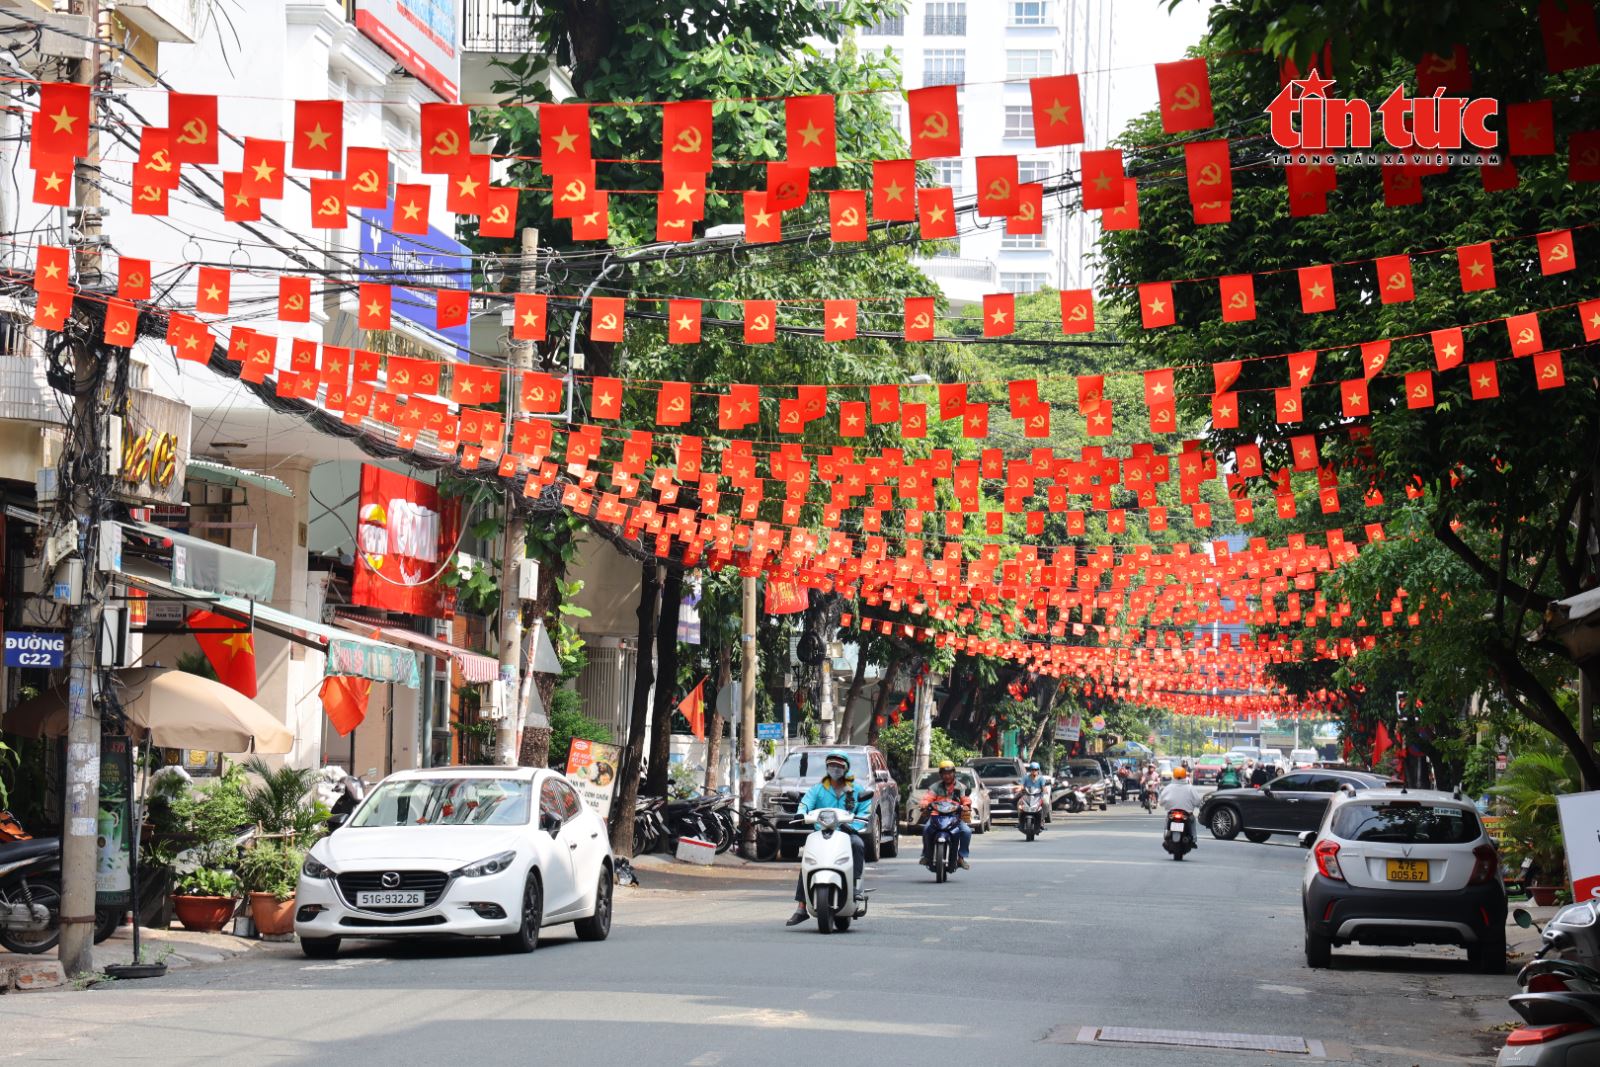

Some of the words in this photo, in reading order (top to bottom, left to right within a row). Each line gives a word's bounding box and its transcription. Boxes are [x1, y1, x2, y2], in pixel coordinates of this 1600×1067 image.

[5, 634, 64, 651] ĐƯỜNG
[19, 653, 51, 666] C22
[1398, 862, 1417, 870] 47E
[1391, 871, 1424, 880] 005.67
[362, 894, 419, 904] 51G-932.26
